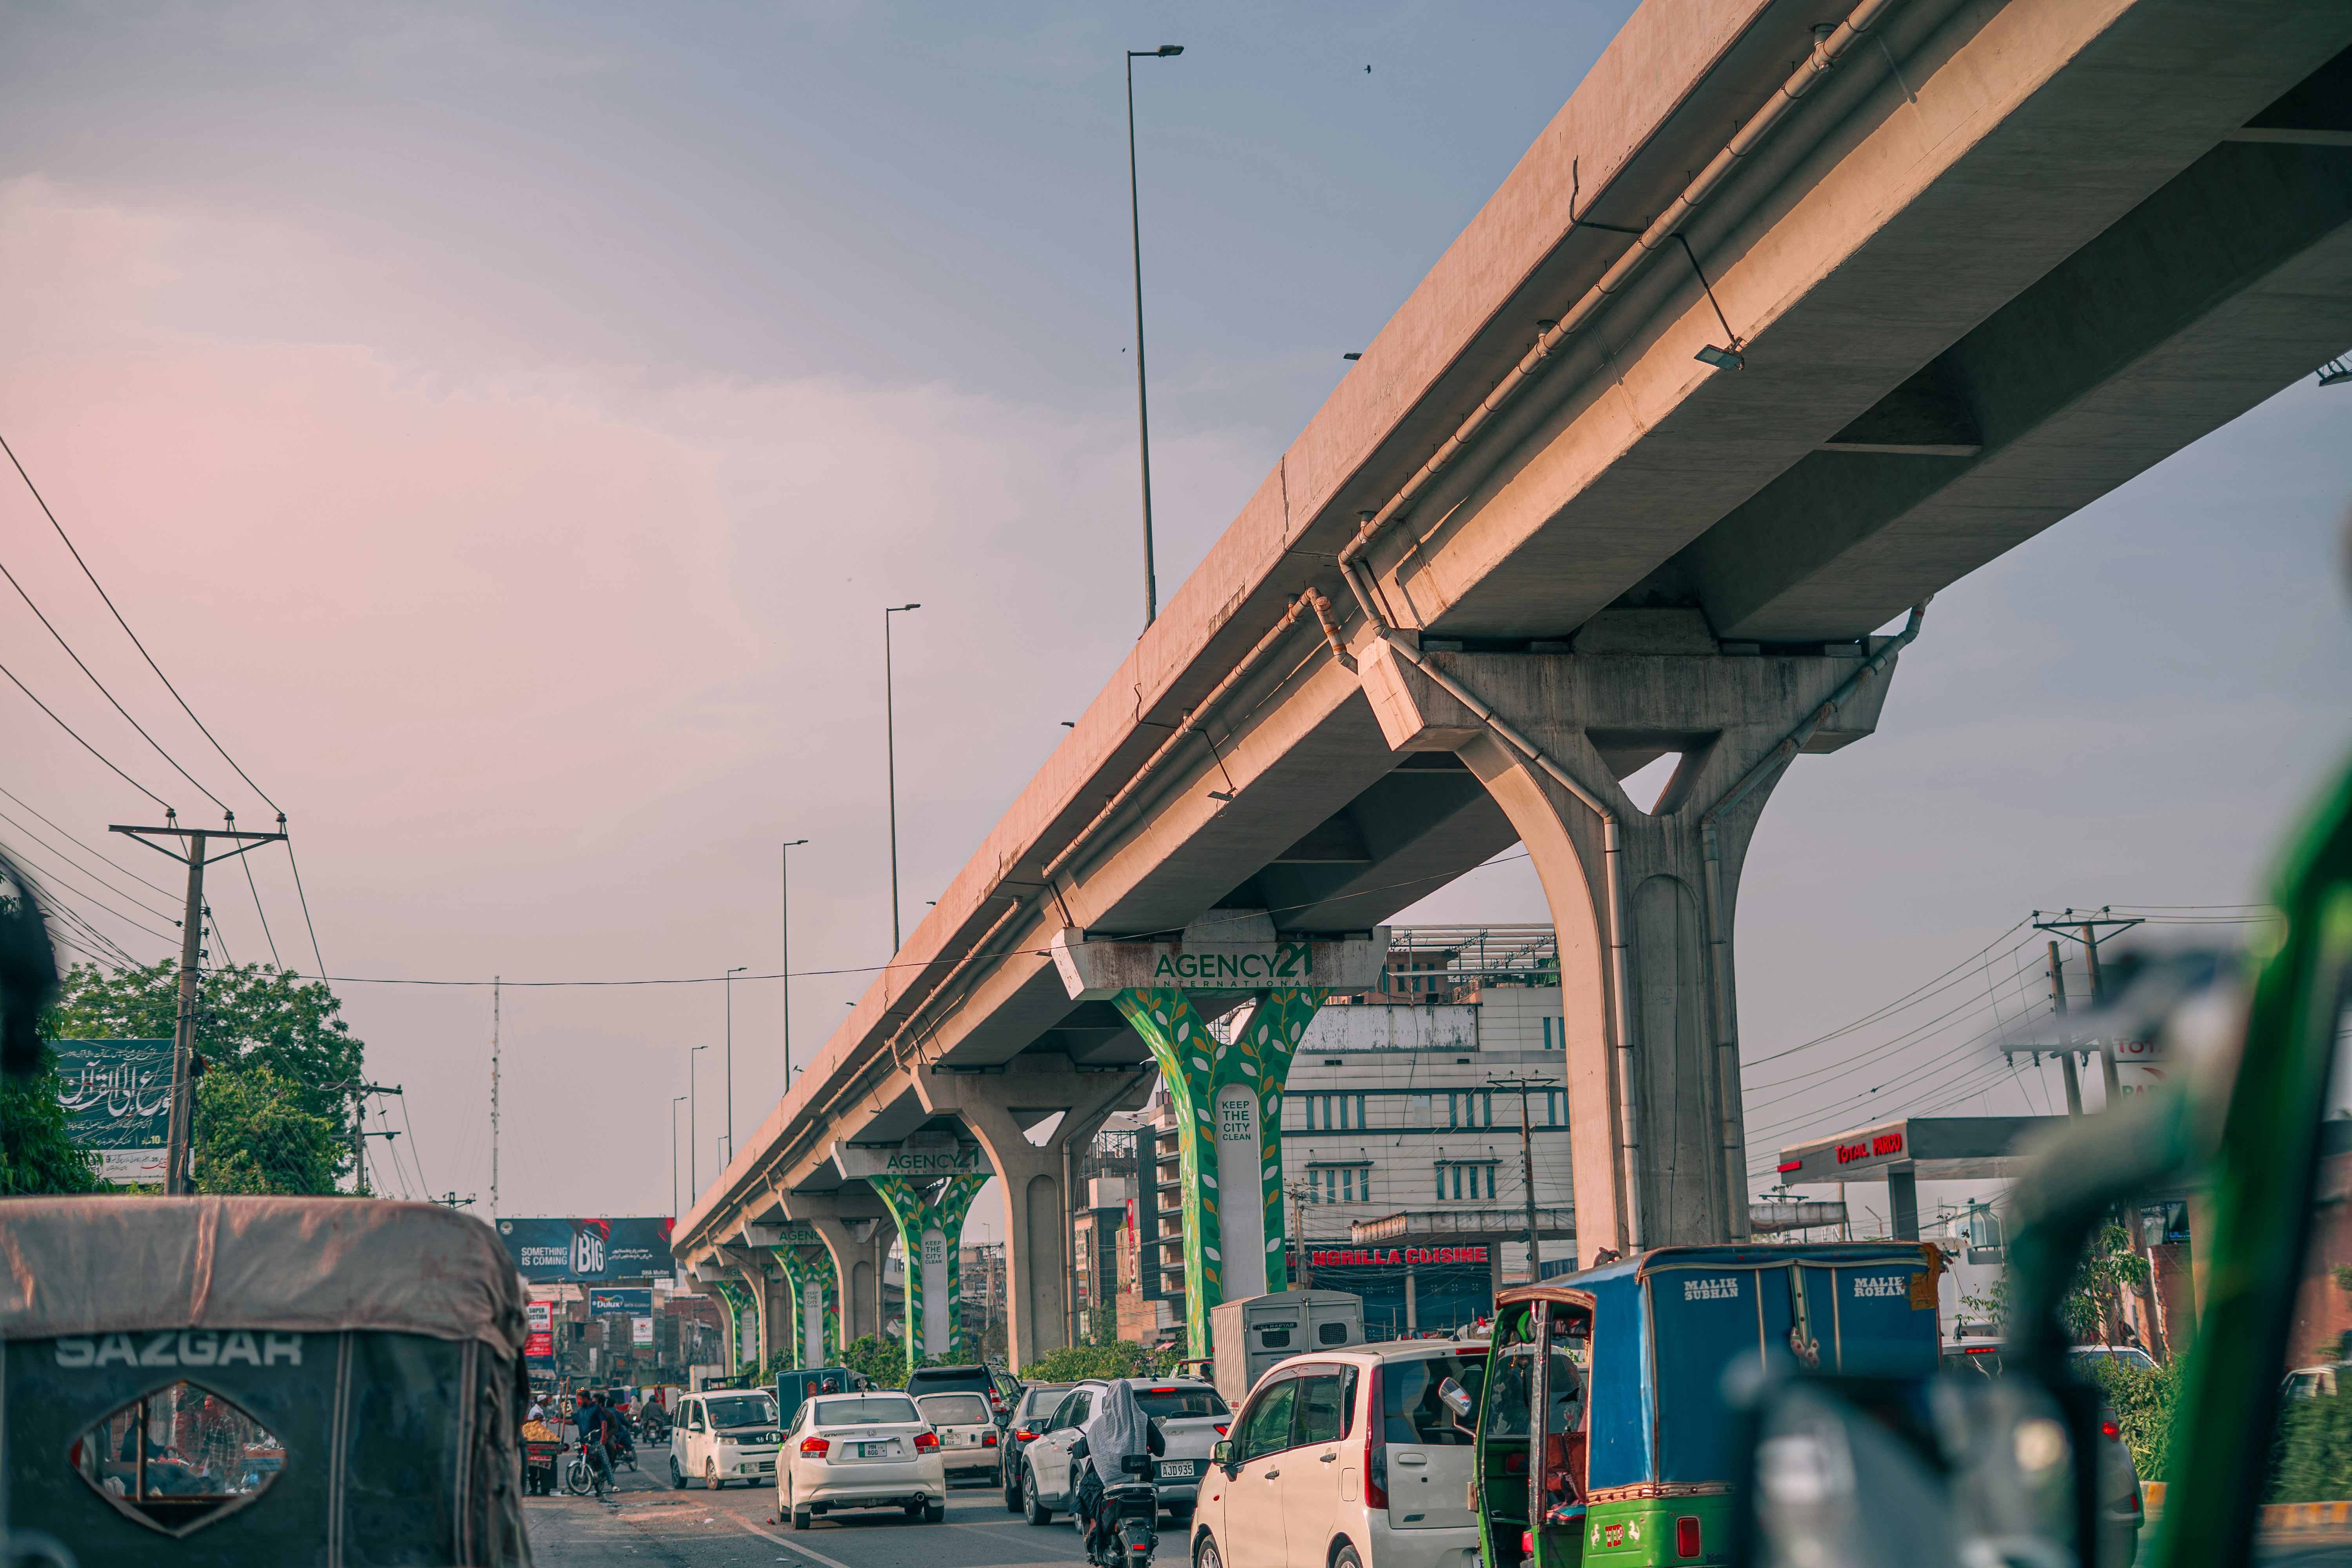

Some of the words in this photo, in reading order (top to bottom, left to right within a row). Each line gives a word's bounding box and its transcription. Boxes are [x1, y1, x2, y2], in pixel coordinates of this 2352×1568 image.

[1222, 1101, 1249, 1109] KEEP
[1223, 1110, 1249, 1121] THE
[1223, 1123, 1250, 1132] CITY
[150, 1135, 160, 1144] 10
[1873, 1132, 1901, 1156] PARCO
[521, 1247, 568, 1256] SOMETHING
[578, 1232, 604, 1272] BIG
[1405, 1247, 1488, 1263] CUISINE
[522, 1256, 530, 1266] IS
[533, 1256, 568, 1266] COMING
[1684, 1278, 1738, 1291] MALIK
[1684, 1287, 1739, 1301] SUBHAN
[1854, 1286, 1905, 1297] ROHAN
[55, 1332, 303, 1367] SAZGAR
[1605, 1524, 1624, 1548] VIP
